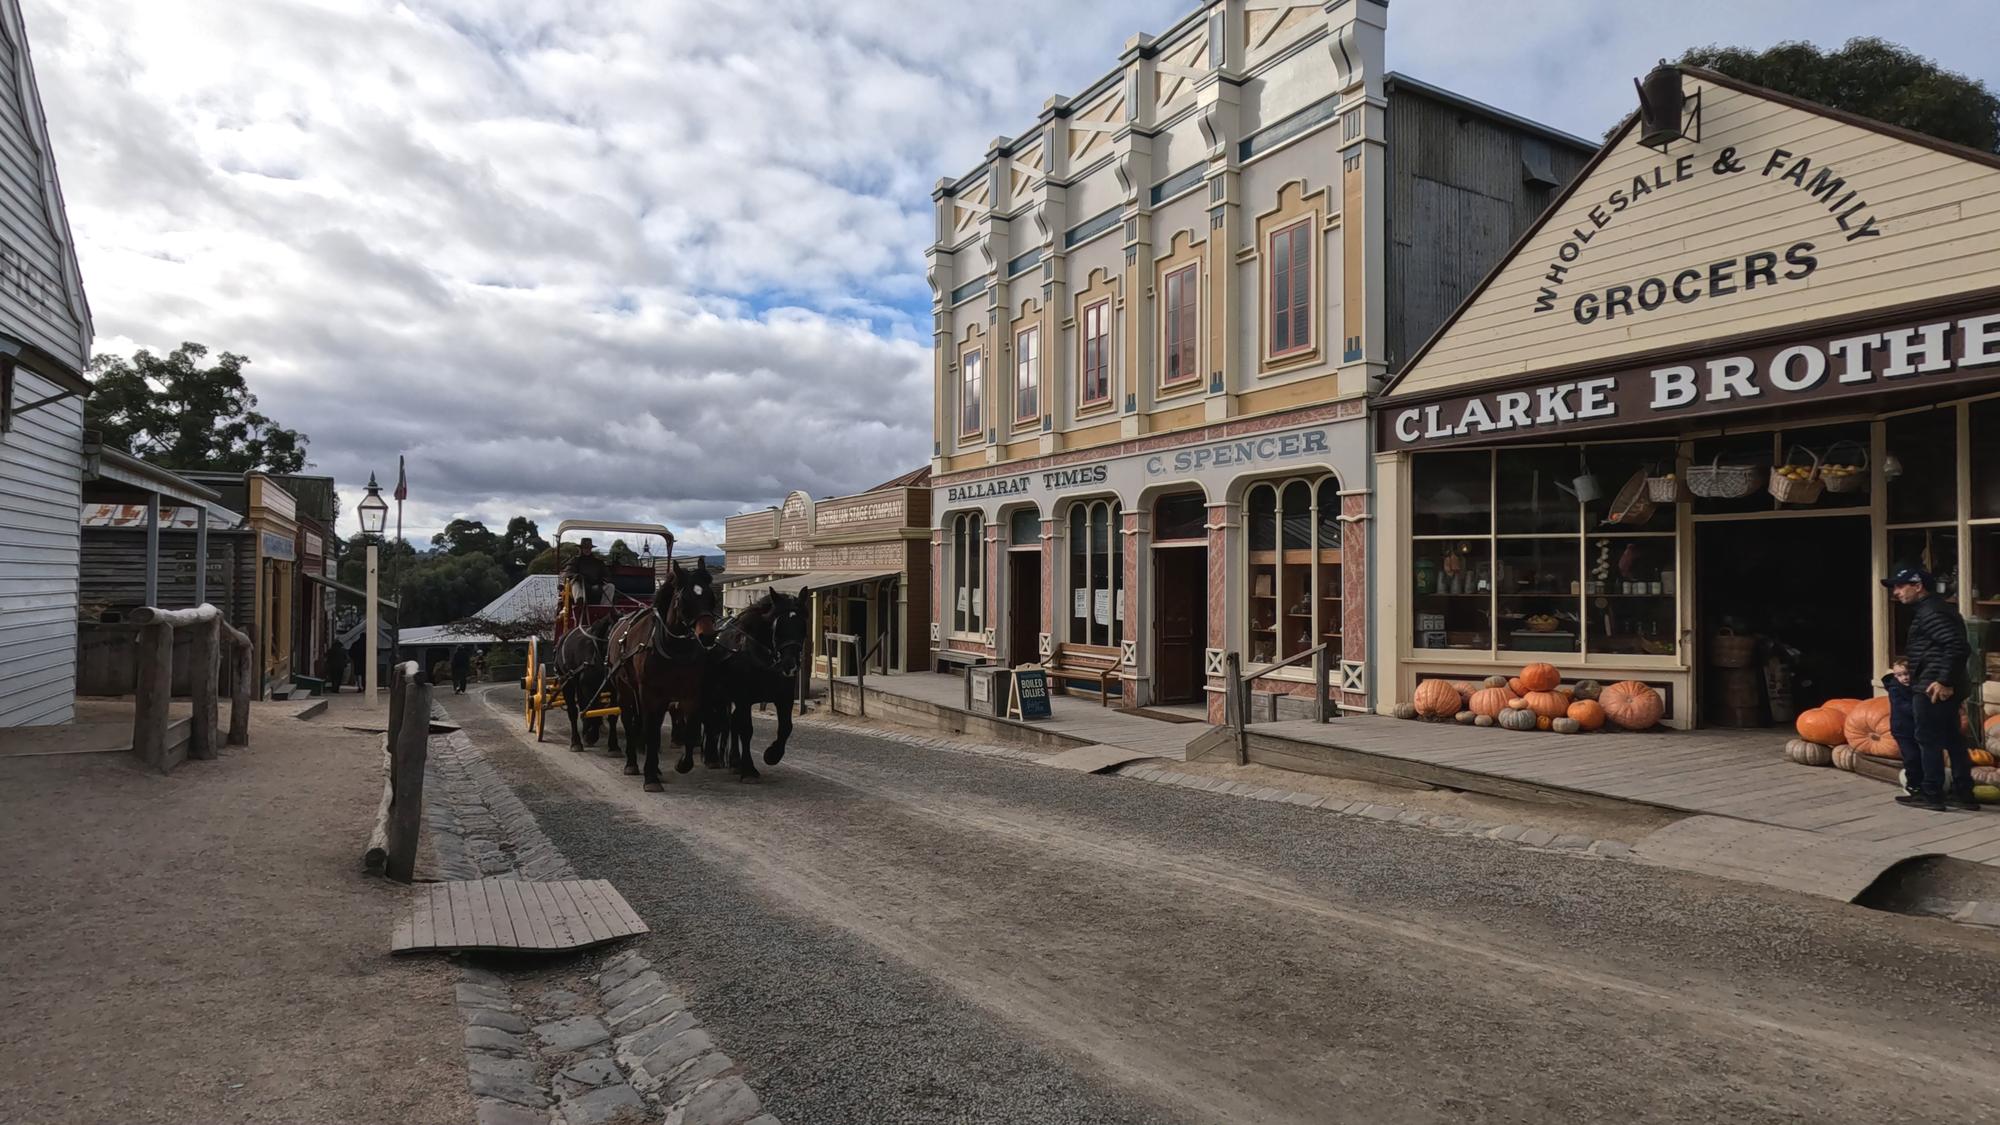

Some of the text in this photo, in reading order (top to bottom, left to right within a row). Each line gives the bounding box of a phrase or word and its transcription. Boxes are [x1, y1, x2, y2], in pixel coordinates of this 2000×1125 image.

[1533, 146, 1881, 313] WHOLESALE & FAMILY
[1573, 241, 1819, 326] GROCERS
[1395, 376, 1617, 443] CLARKE
[1146, 430, 1331, 476] C. SPENCER
[948, 464, 1109, 503] BALLARAT TIMES
[849, 504, 868, 522] STAGE
[784, 541, 803, 552] HOTEL
[779, 557, 810, 570] STABLES
[1021, 678, 1043, 689] BOILED
[1022, 688, 1046, 698] LOLLIES
